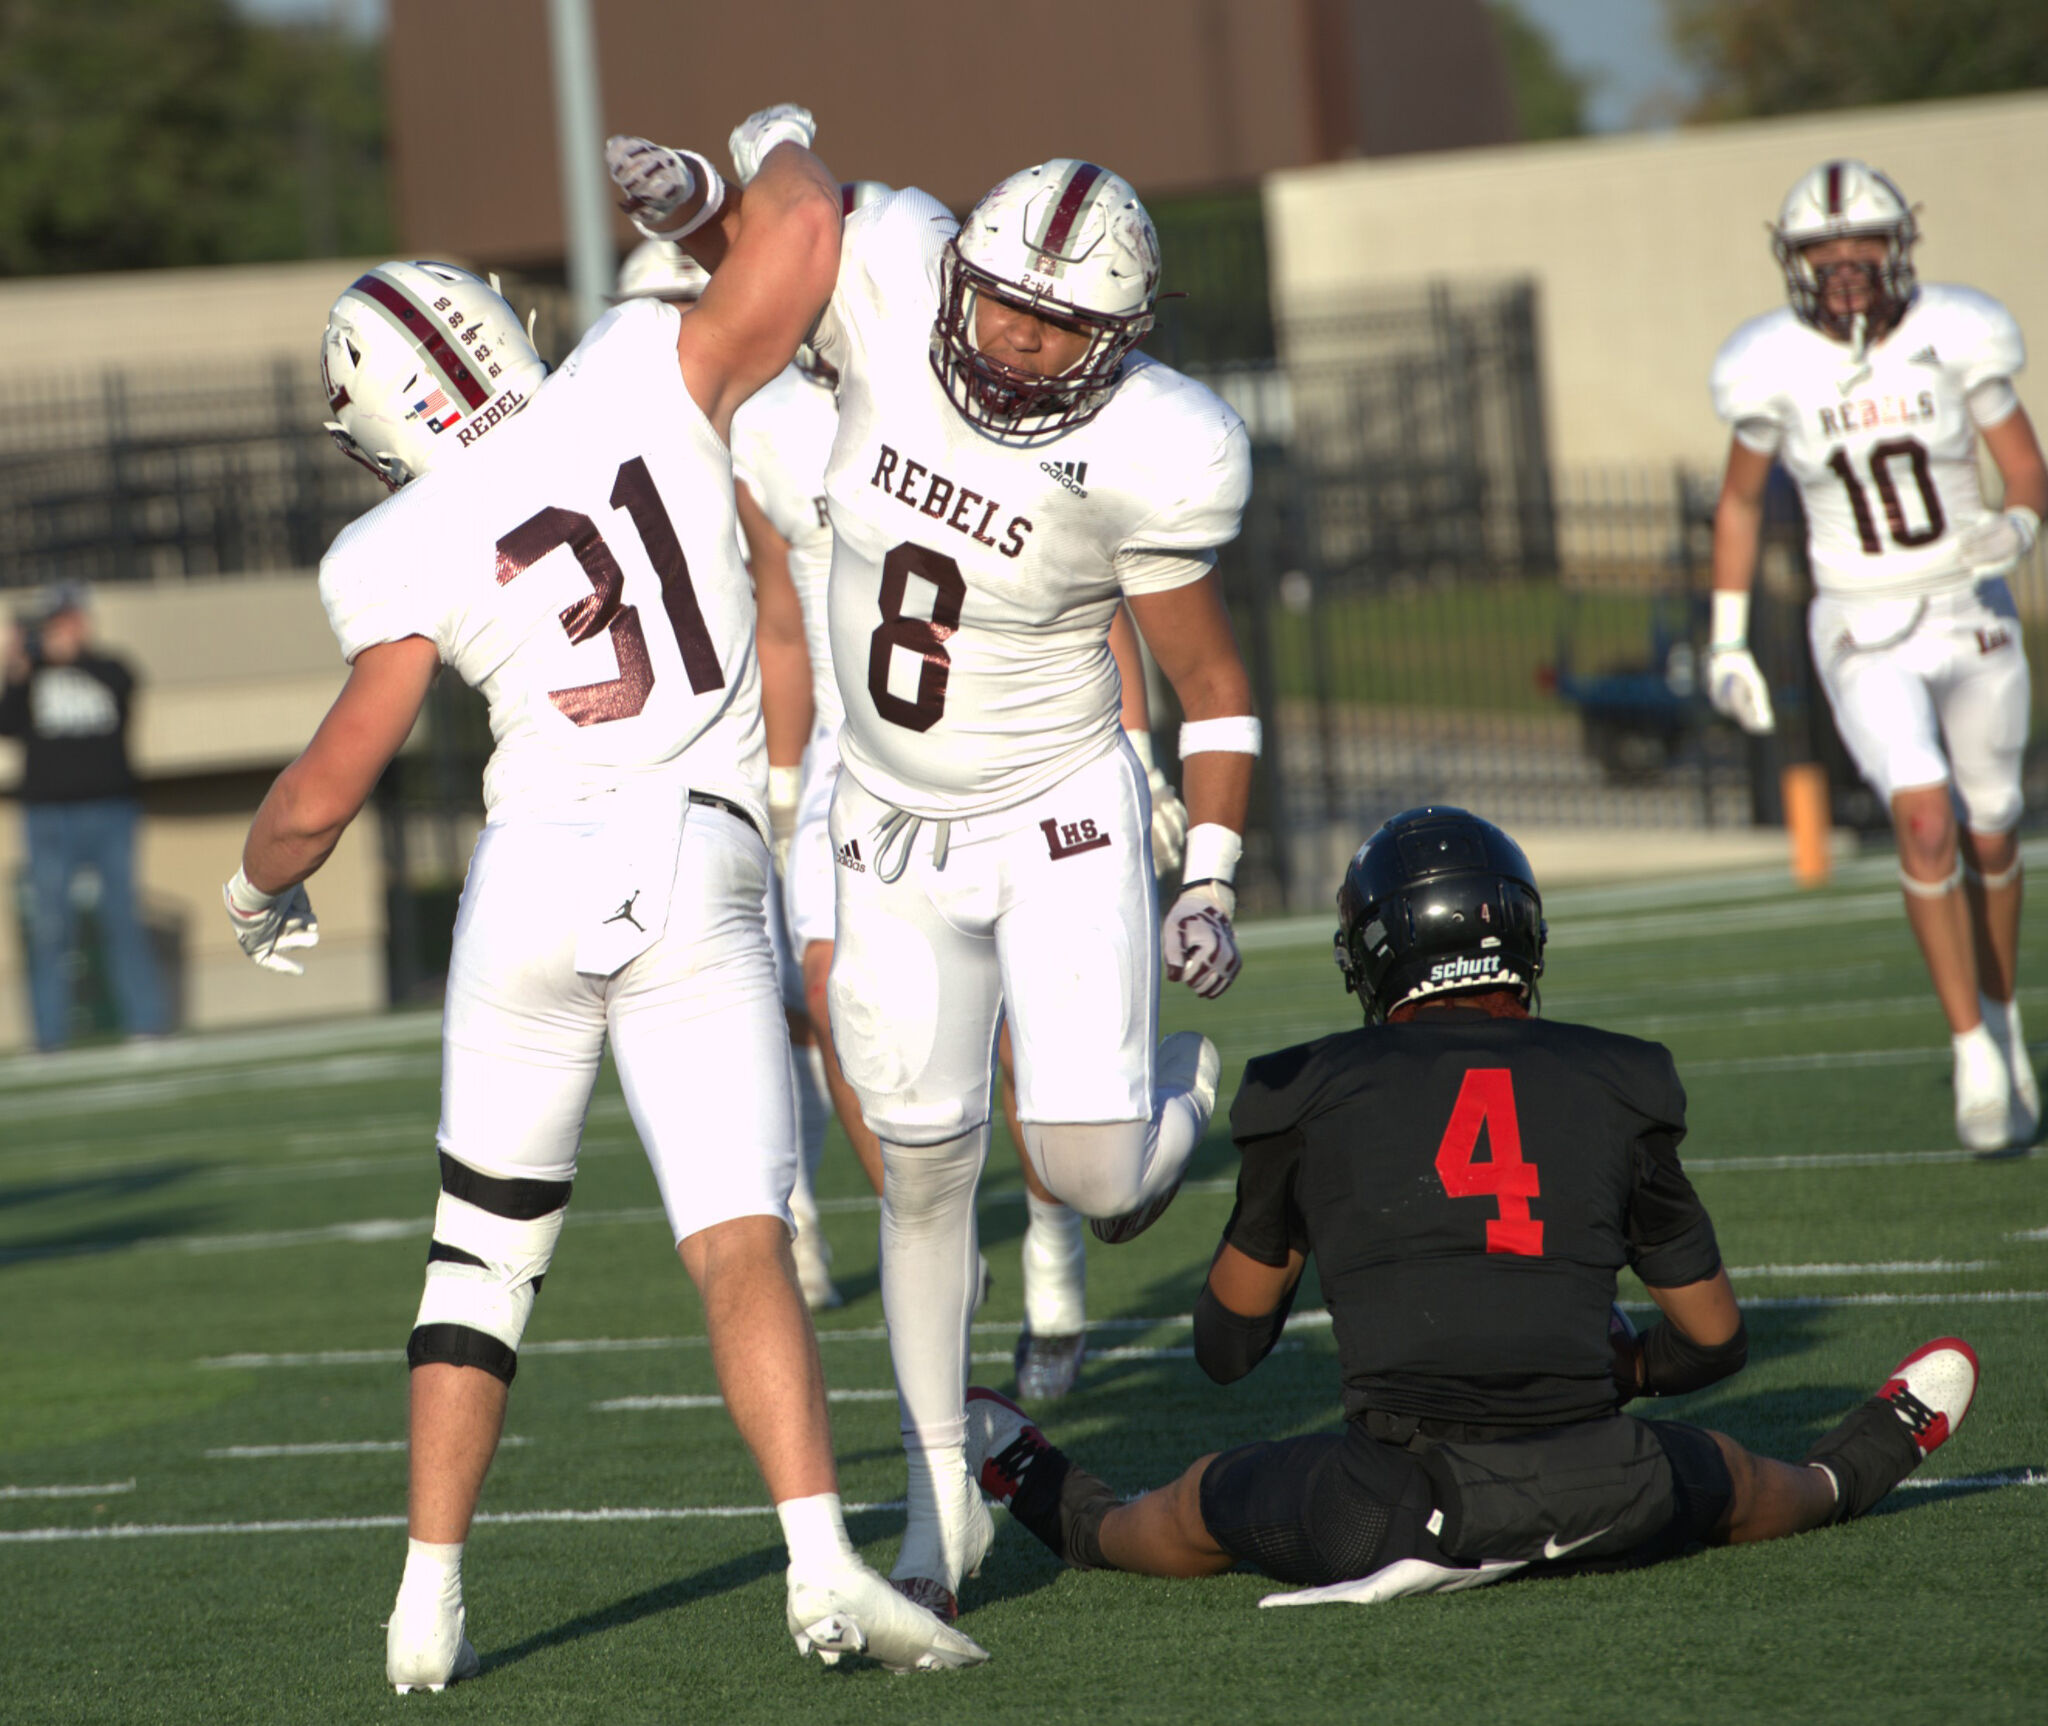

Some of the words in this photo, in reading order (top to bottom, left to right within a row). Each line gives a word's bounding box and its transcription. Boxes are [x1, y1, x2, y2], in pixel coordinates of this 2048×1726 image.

[448, 311, 464, 329] 99
[460, 329, 478, 346] 98
[474, 344, 491, 363] 83
[488, 362, 503, 379] 61
[456, 390, 524, 448] REBEL
[1040, 461, 1088, 499] adidas
[1827, 435, 1947, 555] 10
[870, 443, 1033, 559] REBELS
[495, 455, 726, 728] 31
[868, 540, 967, 733] 8
[1039, 817, 1111, 862] LHS
[1481, 903, 1491, 923] 4
[1430, 955, 1501, 981] schutt
[1434, 1068, 1545, 1257] 4
